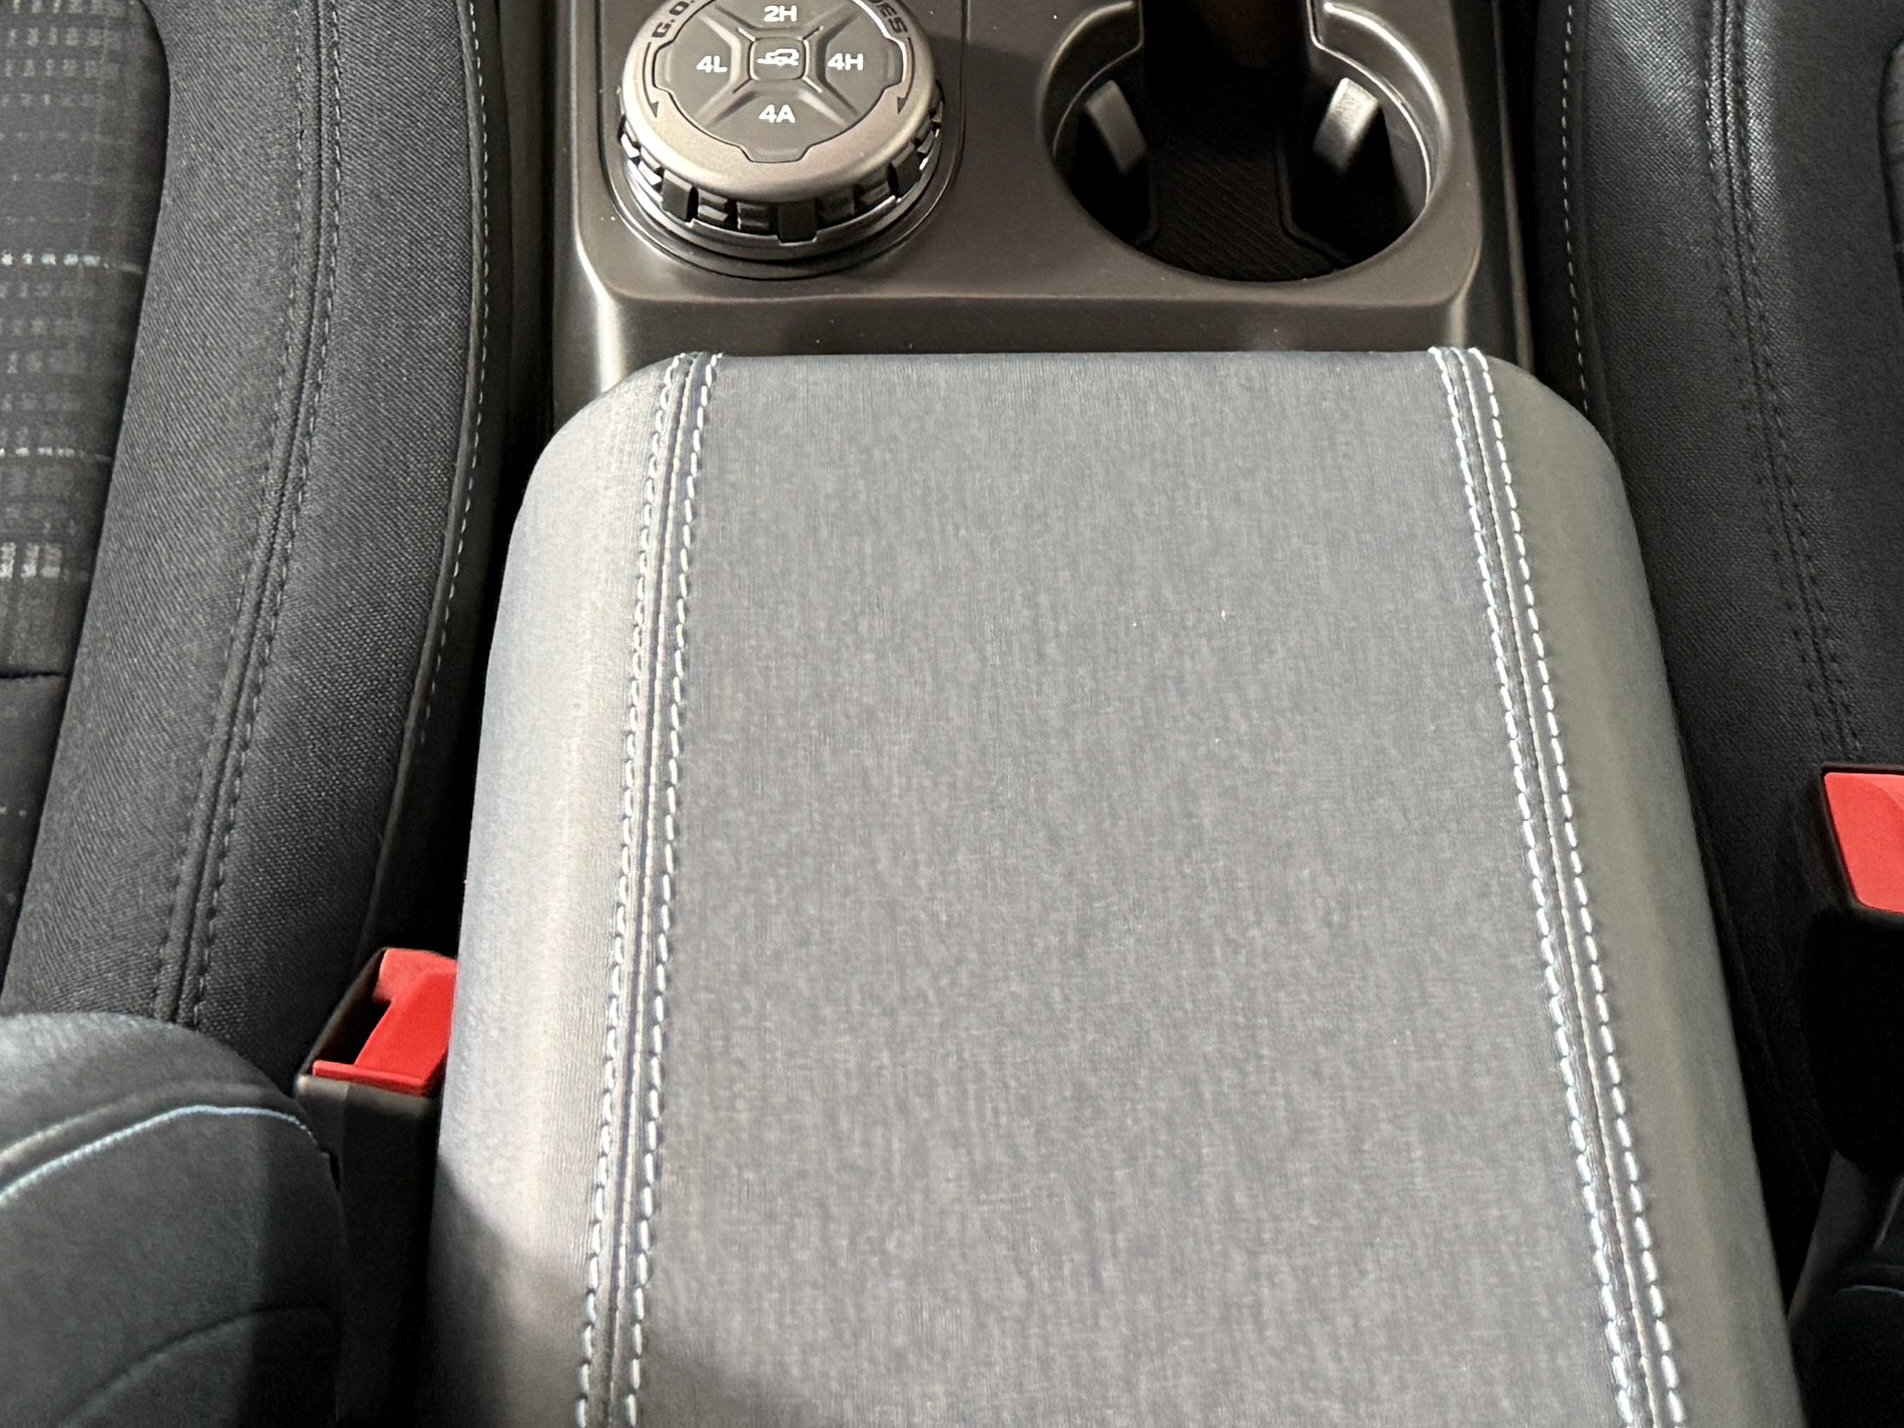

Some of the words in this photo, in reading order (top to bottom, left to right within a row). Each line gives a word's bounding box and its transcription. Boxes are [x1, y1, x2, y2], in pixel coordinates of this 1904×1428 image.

[763, 5, 797, 22] 2H
[696, 55, 728, 73] 4L
[827, 53, 864, 70] 4H
[758, 104, 796, 123] 4A
